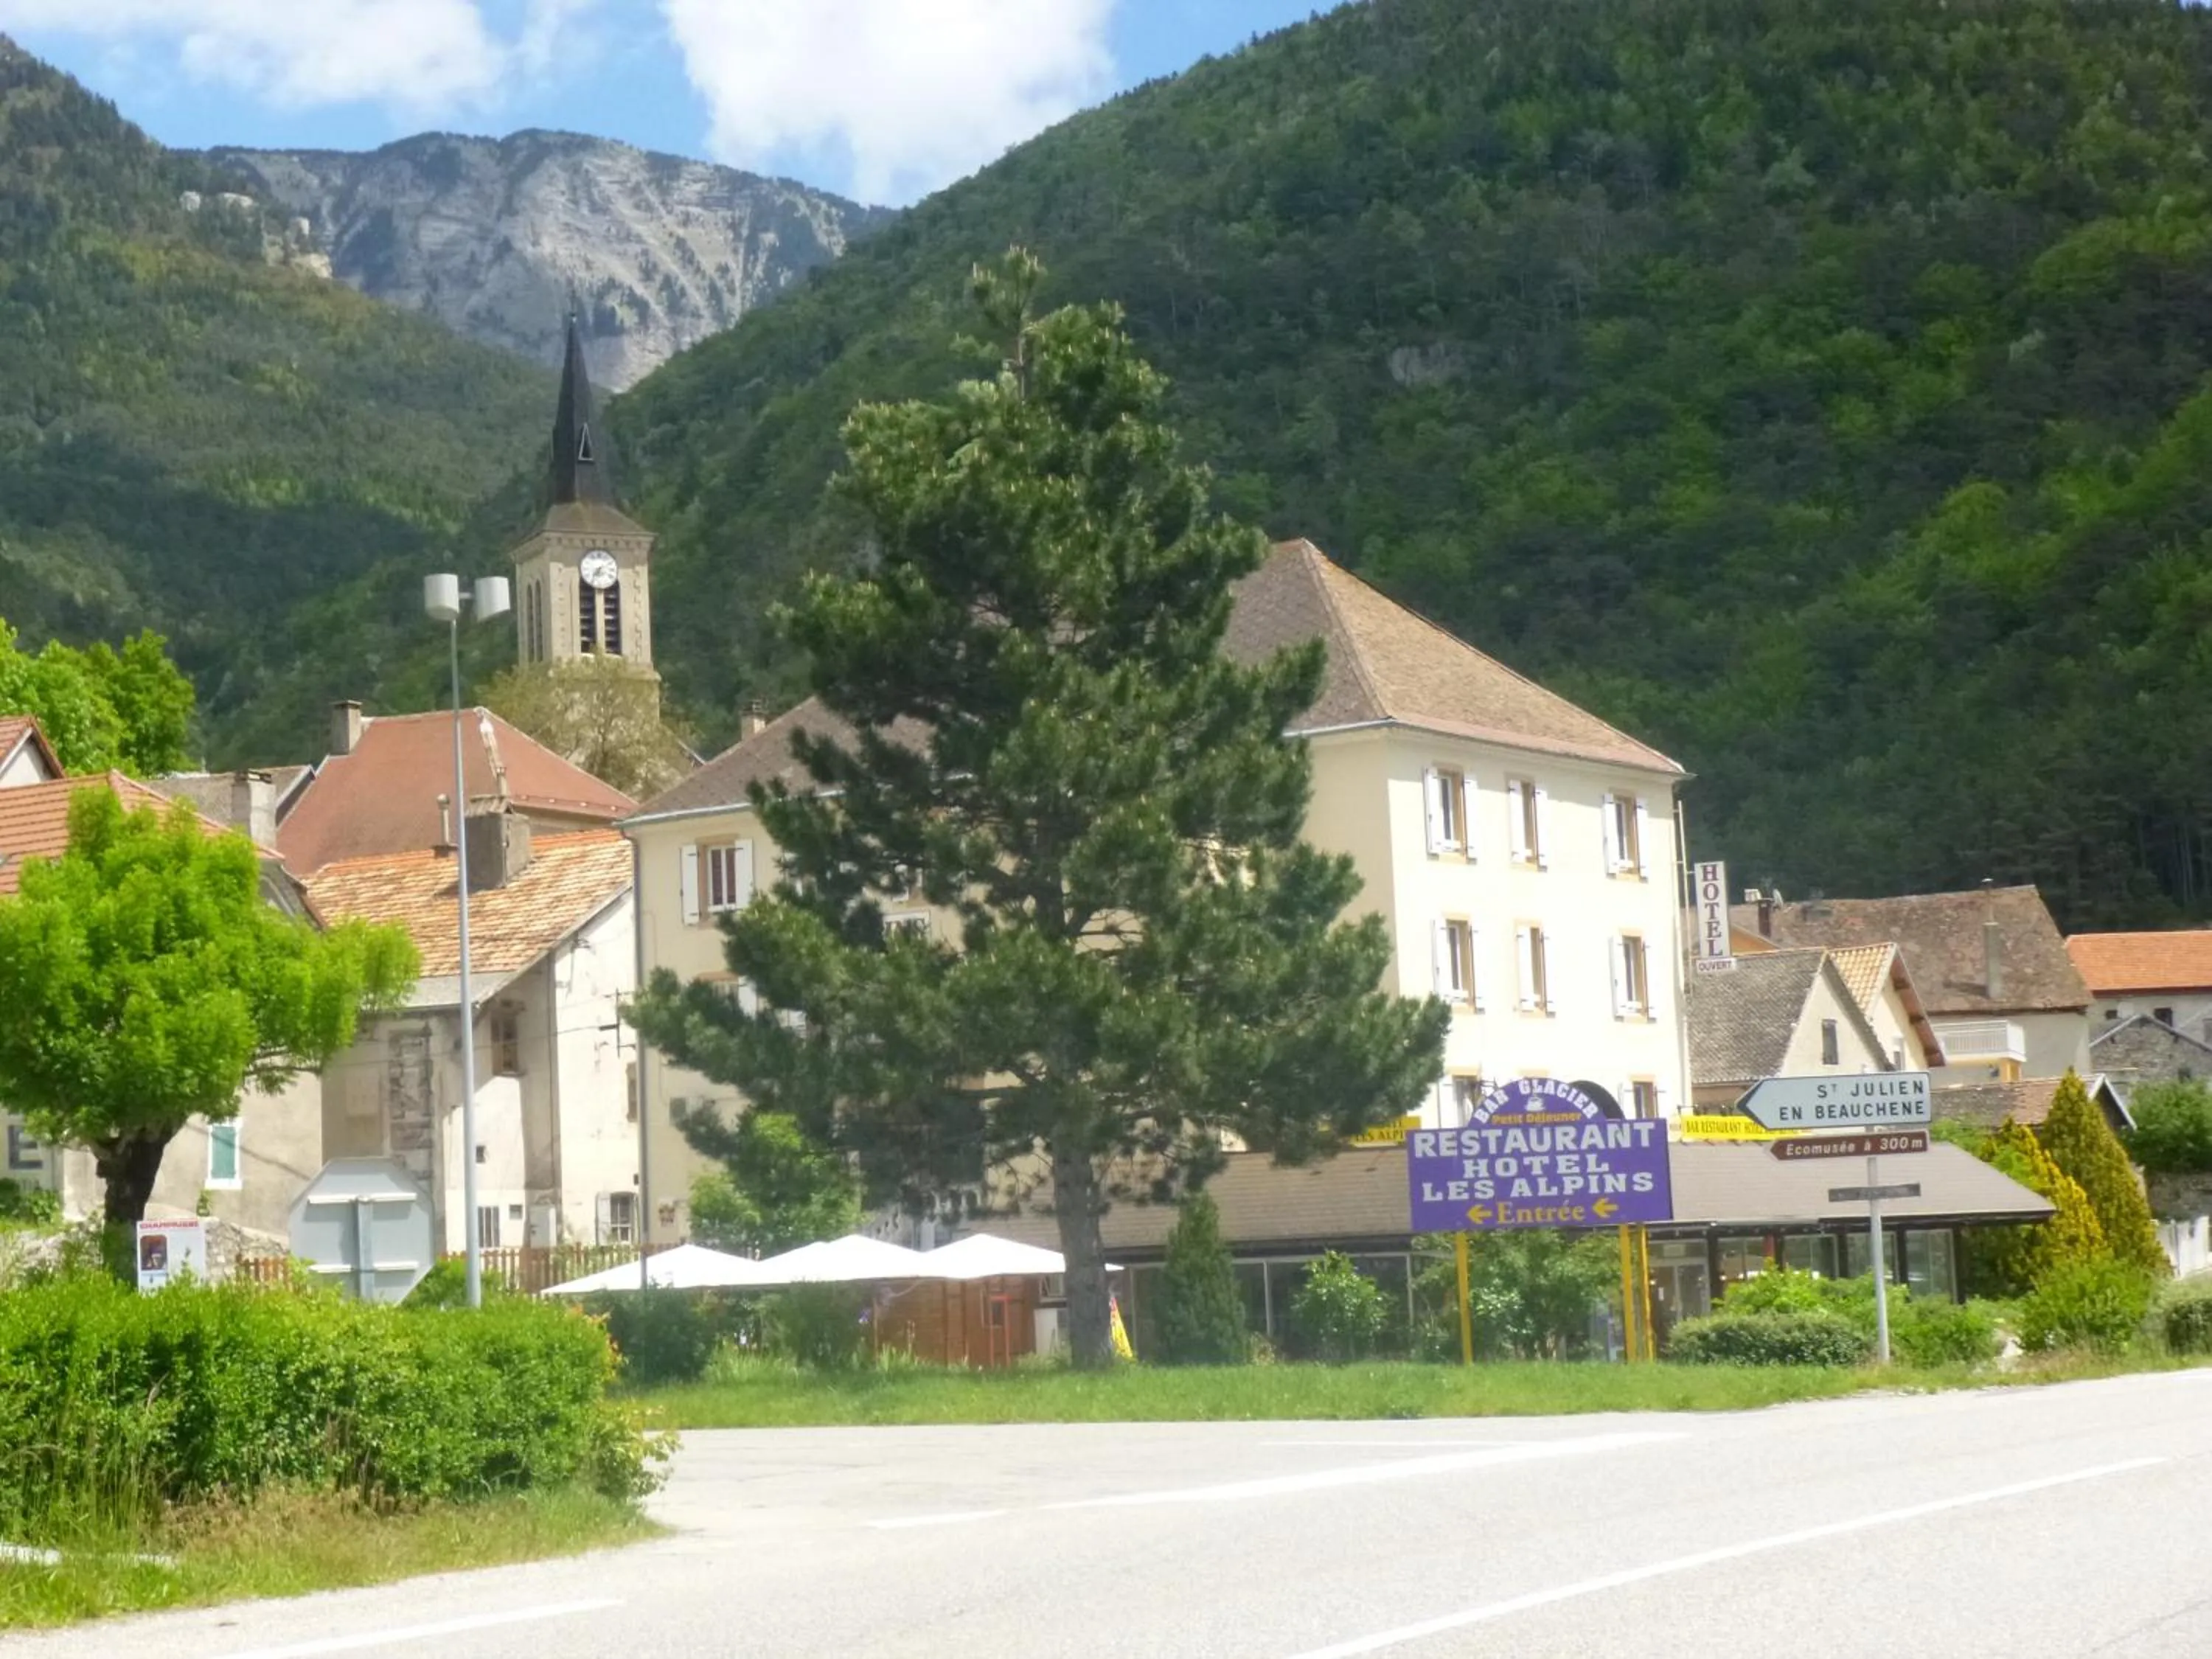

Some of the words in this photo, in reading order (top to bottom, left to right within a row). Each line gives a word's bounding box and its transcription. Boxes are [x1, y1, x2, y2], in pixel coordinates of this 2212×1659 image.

[1700, 864, 1723, 956] HOTEL
[1698, 960, 1732, 971] OUVERT
[1473, 1088, 1509, 1124] BAR
[1517, 1078, 1599, 1119] GLACIER
[1850, 1080, 1924, 1097] JULIEN
[1779, 1107, 1804, 1121] EN
[1815, 1100, 1925, 1120] BEAUCHENE
[1701, 1119, 1742, 1133] RESTAURANT
[1414, 1121, 1655, 1158] RESTAURANT
[1863, 1138, 1871, 1152] à
[1463, 1154, 1610, 1179] HOTEL
[1422, 1180, 1495, 1203] LES
[1509, 1172, 1654, 1197] ALPINS
[1497, 1200, 1585, 1225] Entrée
